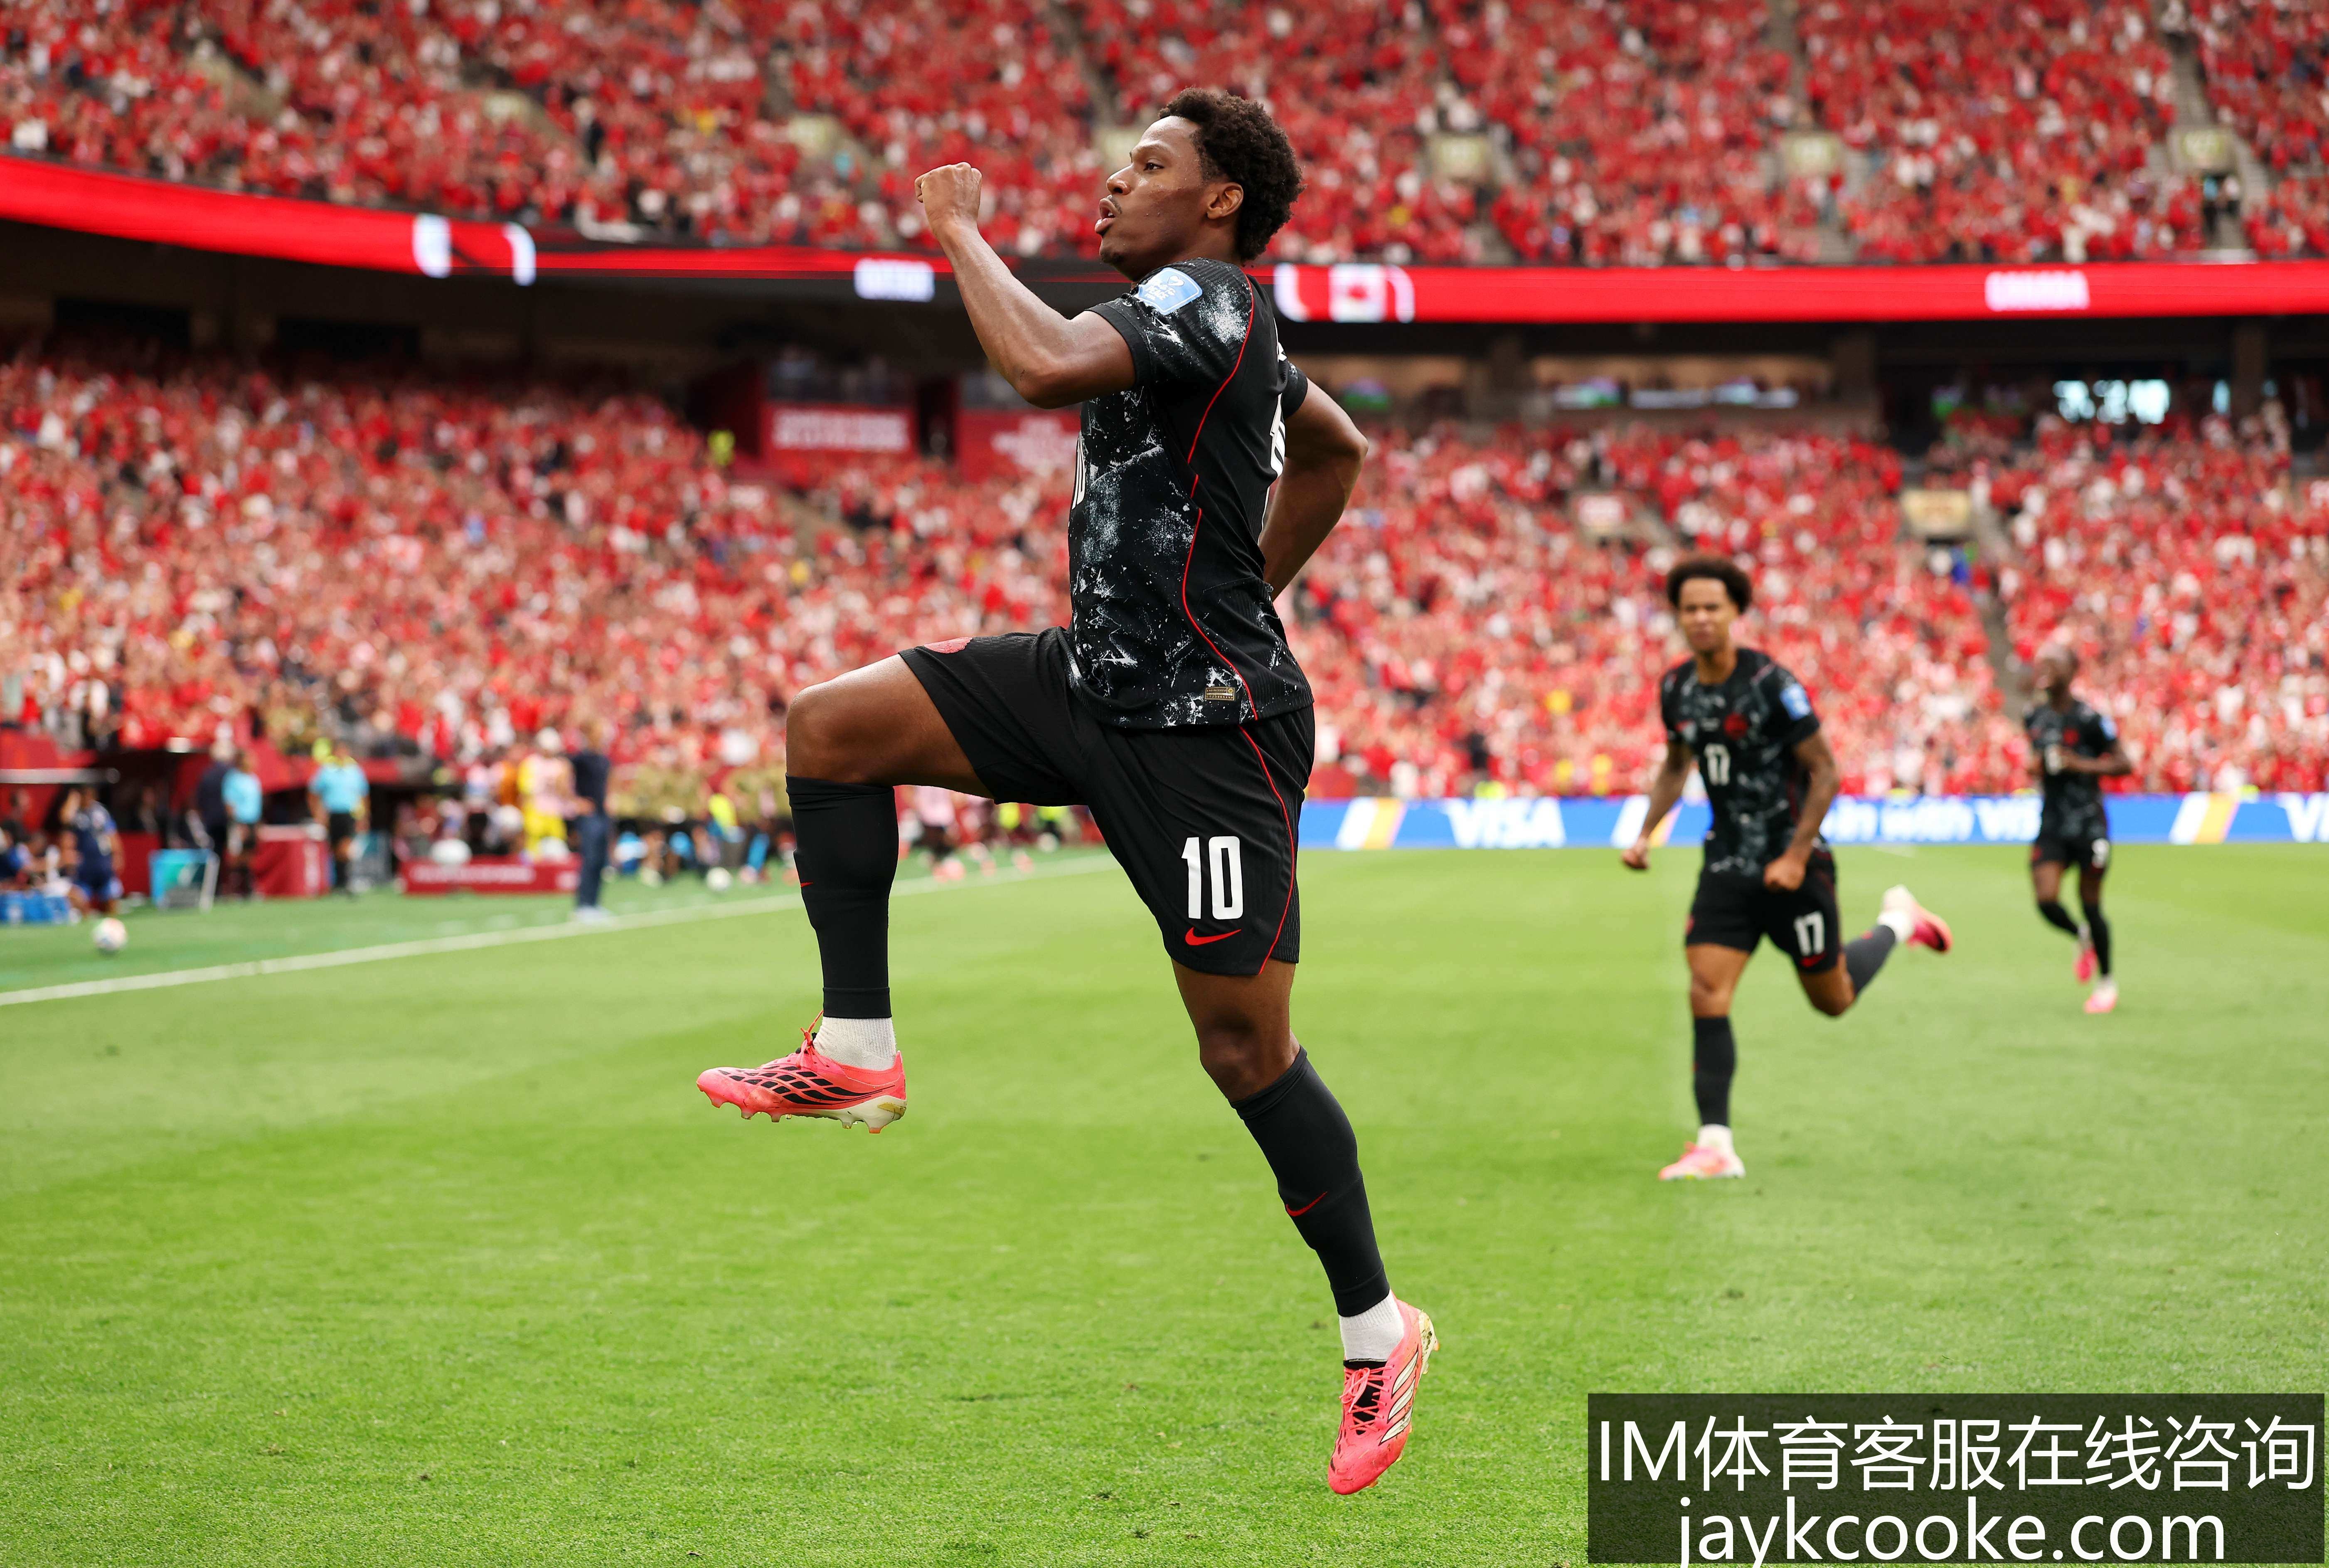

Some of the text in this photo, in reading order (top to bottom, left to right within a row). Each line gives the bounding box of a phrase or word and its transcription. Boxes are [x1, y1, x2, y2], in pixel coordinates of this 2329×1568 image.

[1704, 742, 1731, 786] 17
[1444, 797, 1566, 849] VISA
[1181, 836, 1243, 920] 10
[1793, 911, 1825, 956] 17
